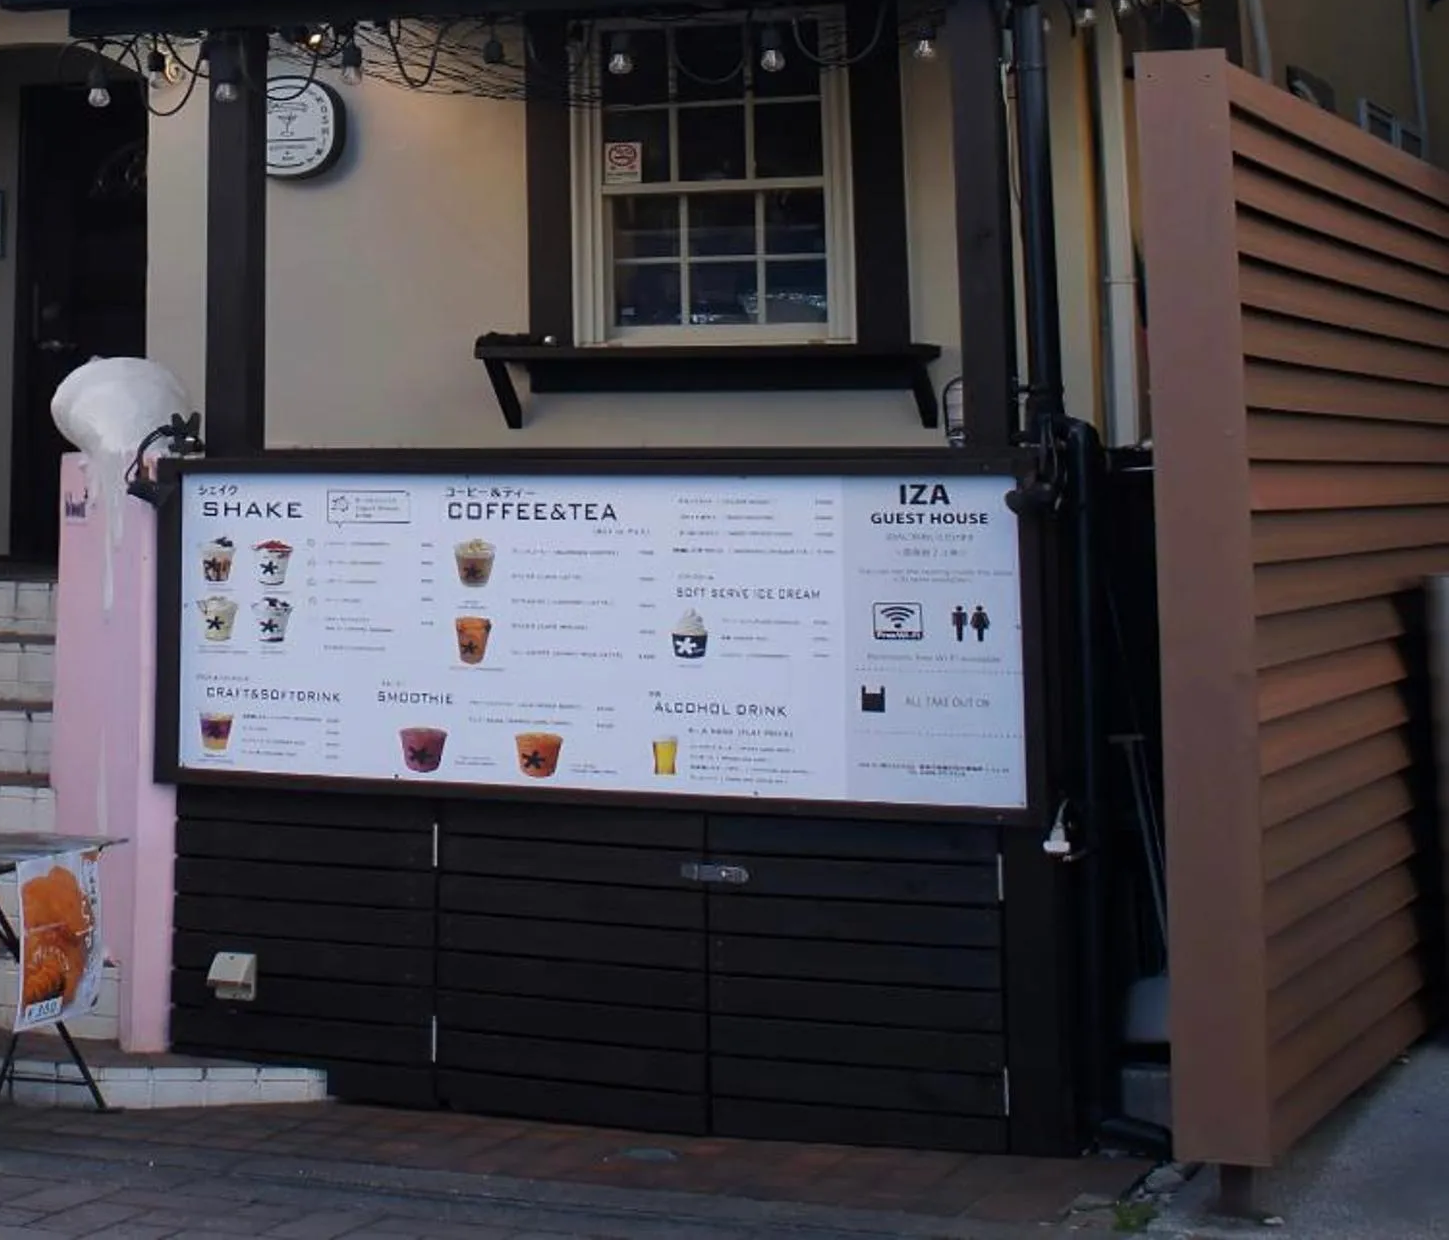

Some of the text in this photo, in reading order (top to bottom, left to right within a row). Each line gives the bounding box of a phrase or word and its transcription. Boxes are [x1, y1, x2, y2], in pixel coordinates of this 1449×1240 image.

[899, 483, 951, 505] IZA
[203, 501, 304, 518] SHAKE
[448, 502, 617, 520] COFFEE&TEA
[870, 512, 990, 525] GUEST HOUSE
[377, 690, 455, 705] SMOOTHIE
[654, 702, 788, 717] ALCOHOL DRINK
